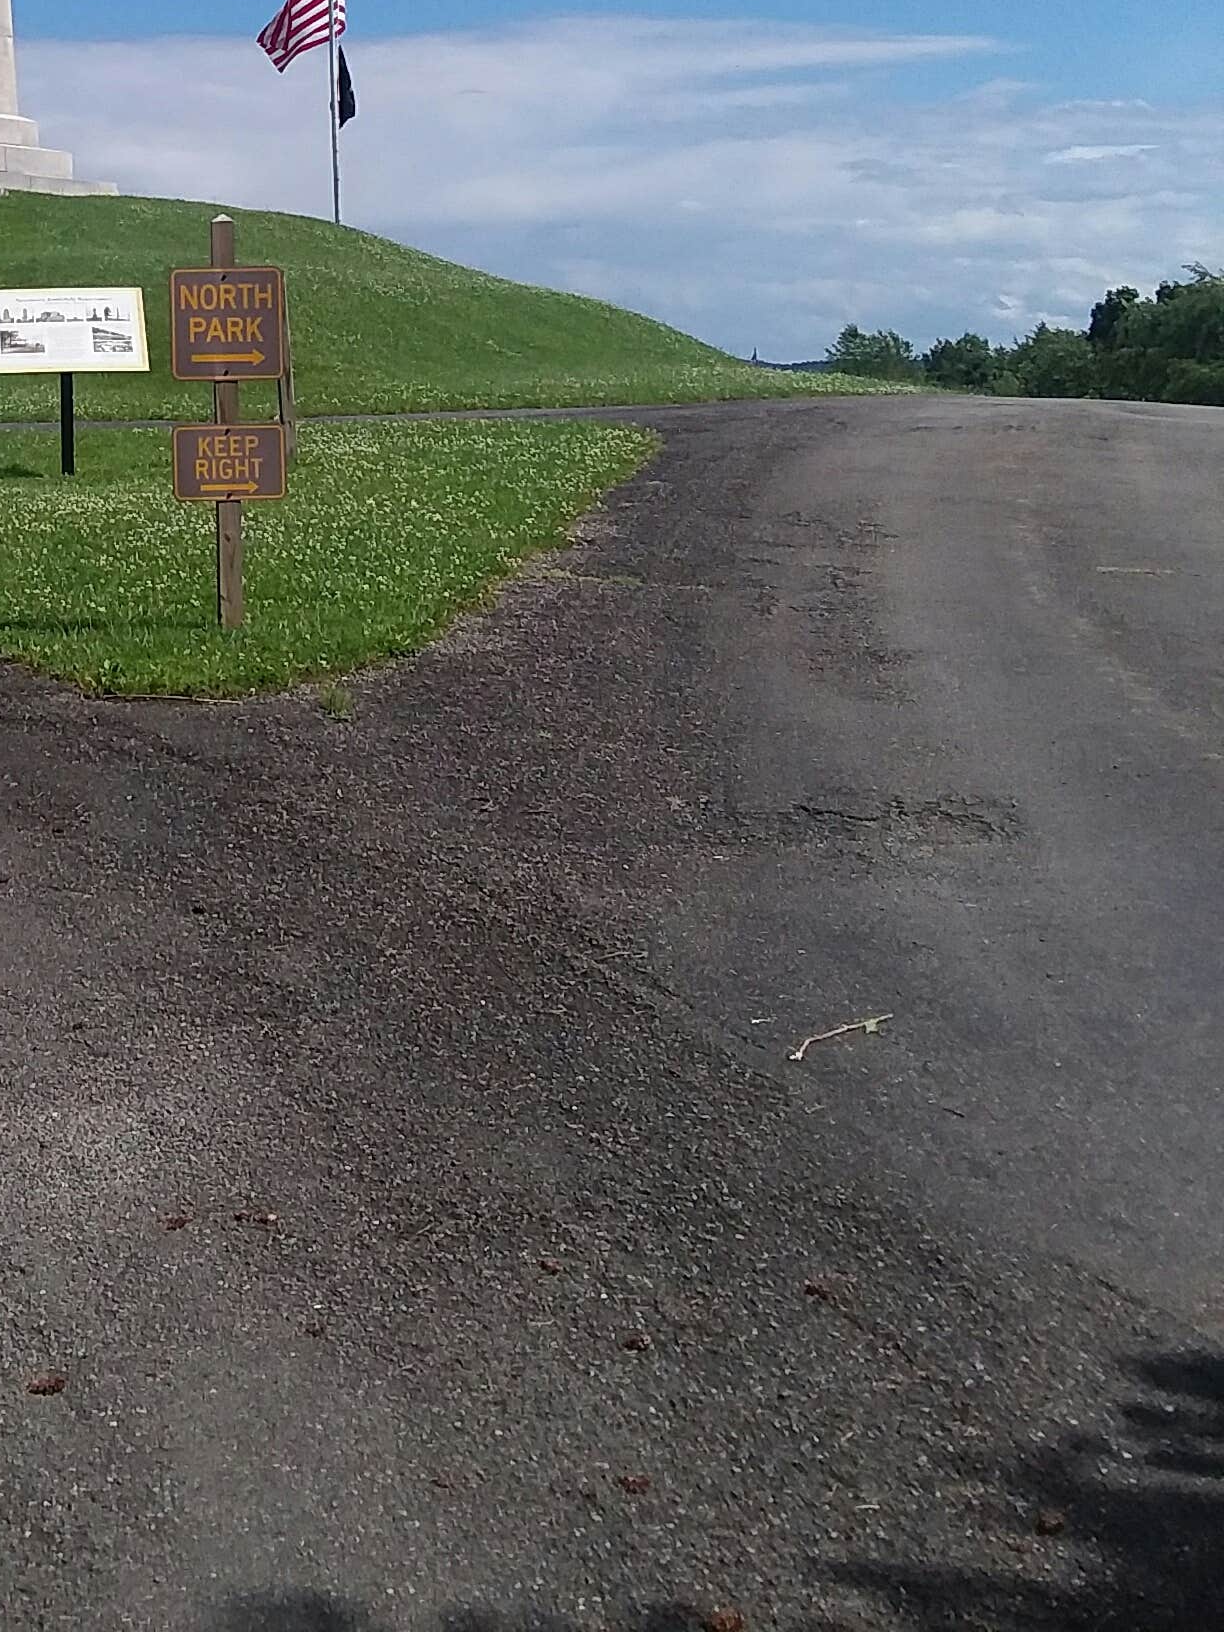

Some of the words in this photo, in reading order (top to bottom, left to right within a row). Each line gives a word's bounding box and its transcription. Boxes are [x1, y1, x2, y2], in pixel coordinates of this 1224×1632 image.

[179, 283, 273, 310] NORTH
[188, 317, 264, 343] PARK
[197, 435, 260, 457] KEEP
[195, 458, 264, 480] RIGHT
